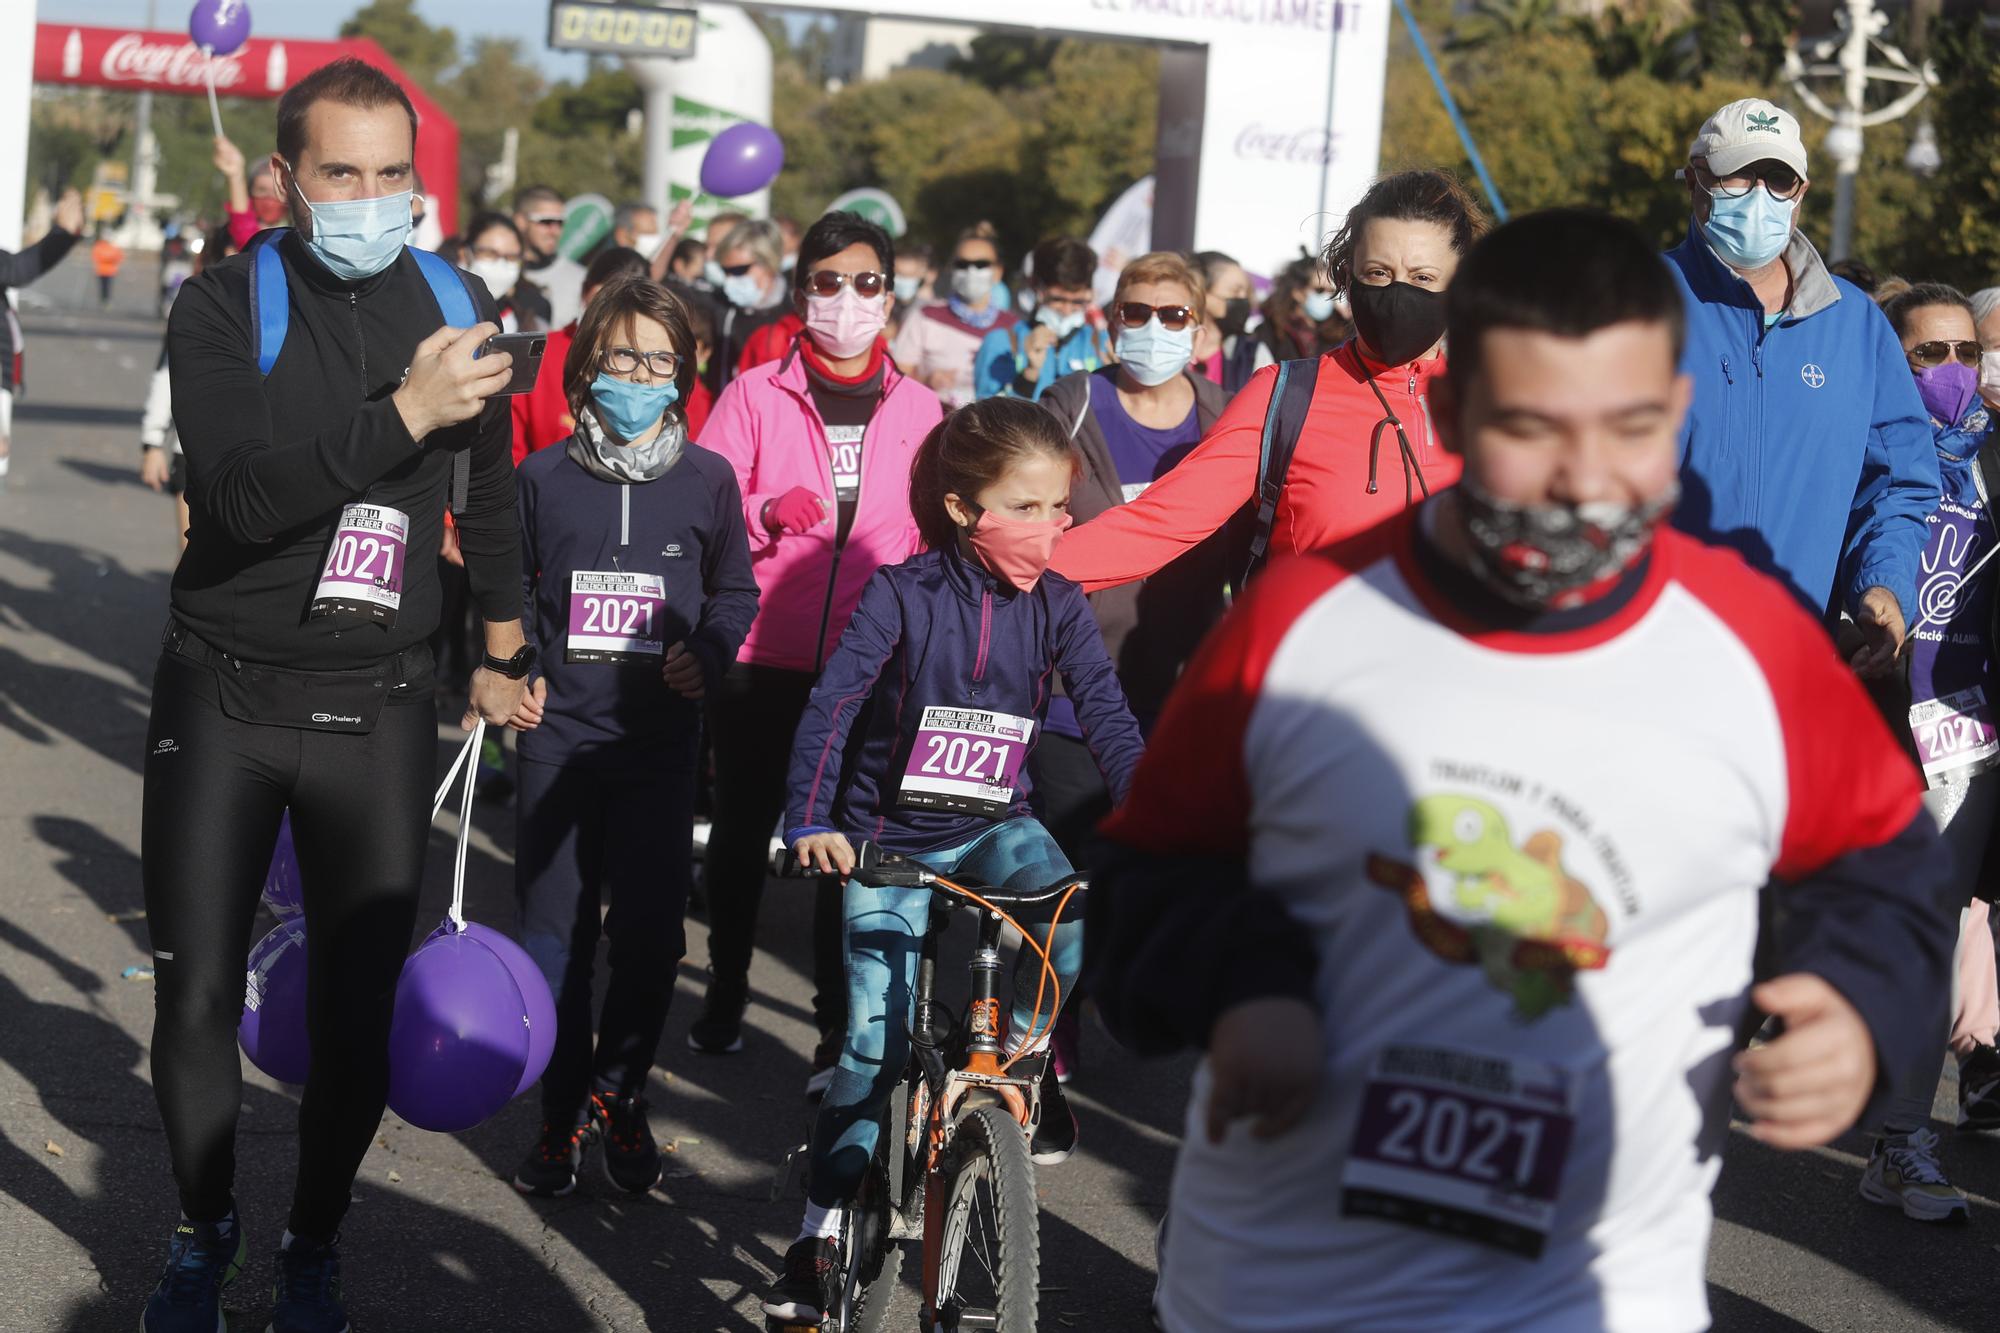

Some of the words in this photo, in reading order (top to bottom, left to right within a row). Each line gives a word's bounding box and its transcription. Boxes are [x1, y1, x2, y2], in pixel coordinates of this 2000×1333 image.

[1746, 123, 1781, 135] adidas
[831, 444, 861, 473] 20
[369, 510, 379, 519] LA
[582, 597, 654, 635] 2021
[332, 715, 362, 724] Kalenji
[934, 710, 957, 720] MARXA
[956, 712, 982, 722] CONTRA
[982, 714, 992, 723] LA
[958, 721, 968, 730] DE
[1919, 711, 1985, 760] 2021
[153, 745, 180, 756] Kalenji
[920, 735, 1010, 782] 2021
[1378, 1090, 1546, 1188] 2021
